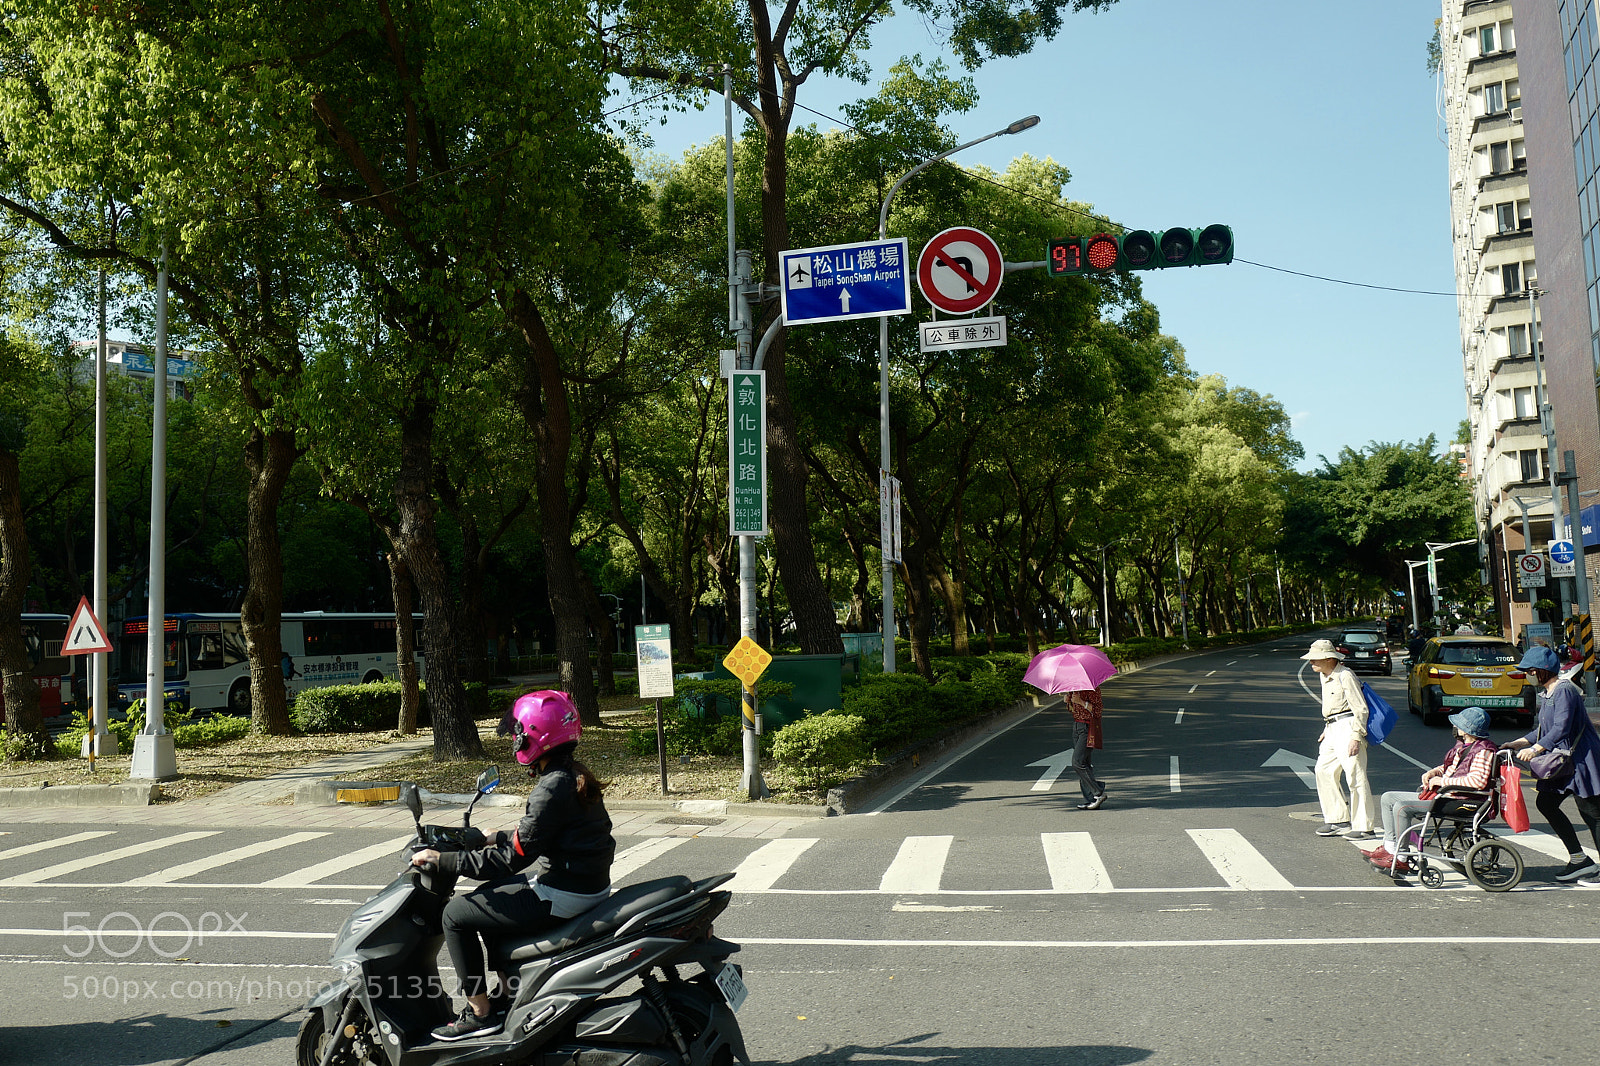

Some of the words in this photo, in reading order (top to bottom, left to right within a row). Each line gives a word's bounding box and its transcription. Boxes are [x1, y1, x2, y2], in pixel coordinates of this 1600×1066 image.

[813, 246, 899, 275] 松山機場
[1052, 245, 1080, 272] 97
[814, 275, 834, 289] Taipei
[836, 272, 872, 286] SongShan
[874, 268, 900, 281] Airport
[930, 326, 995, 343] 公車除外
[738, 388, 757, 481] 敦化北路
[735, 486, 761, 495] DunHua
[750, 521, 761, 530] 207
